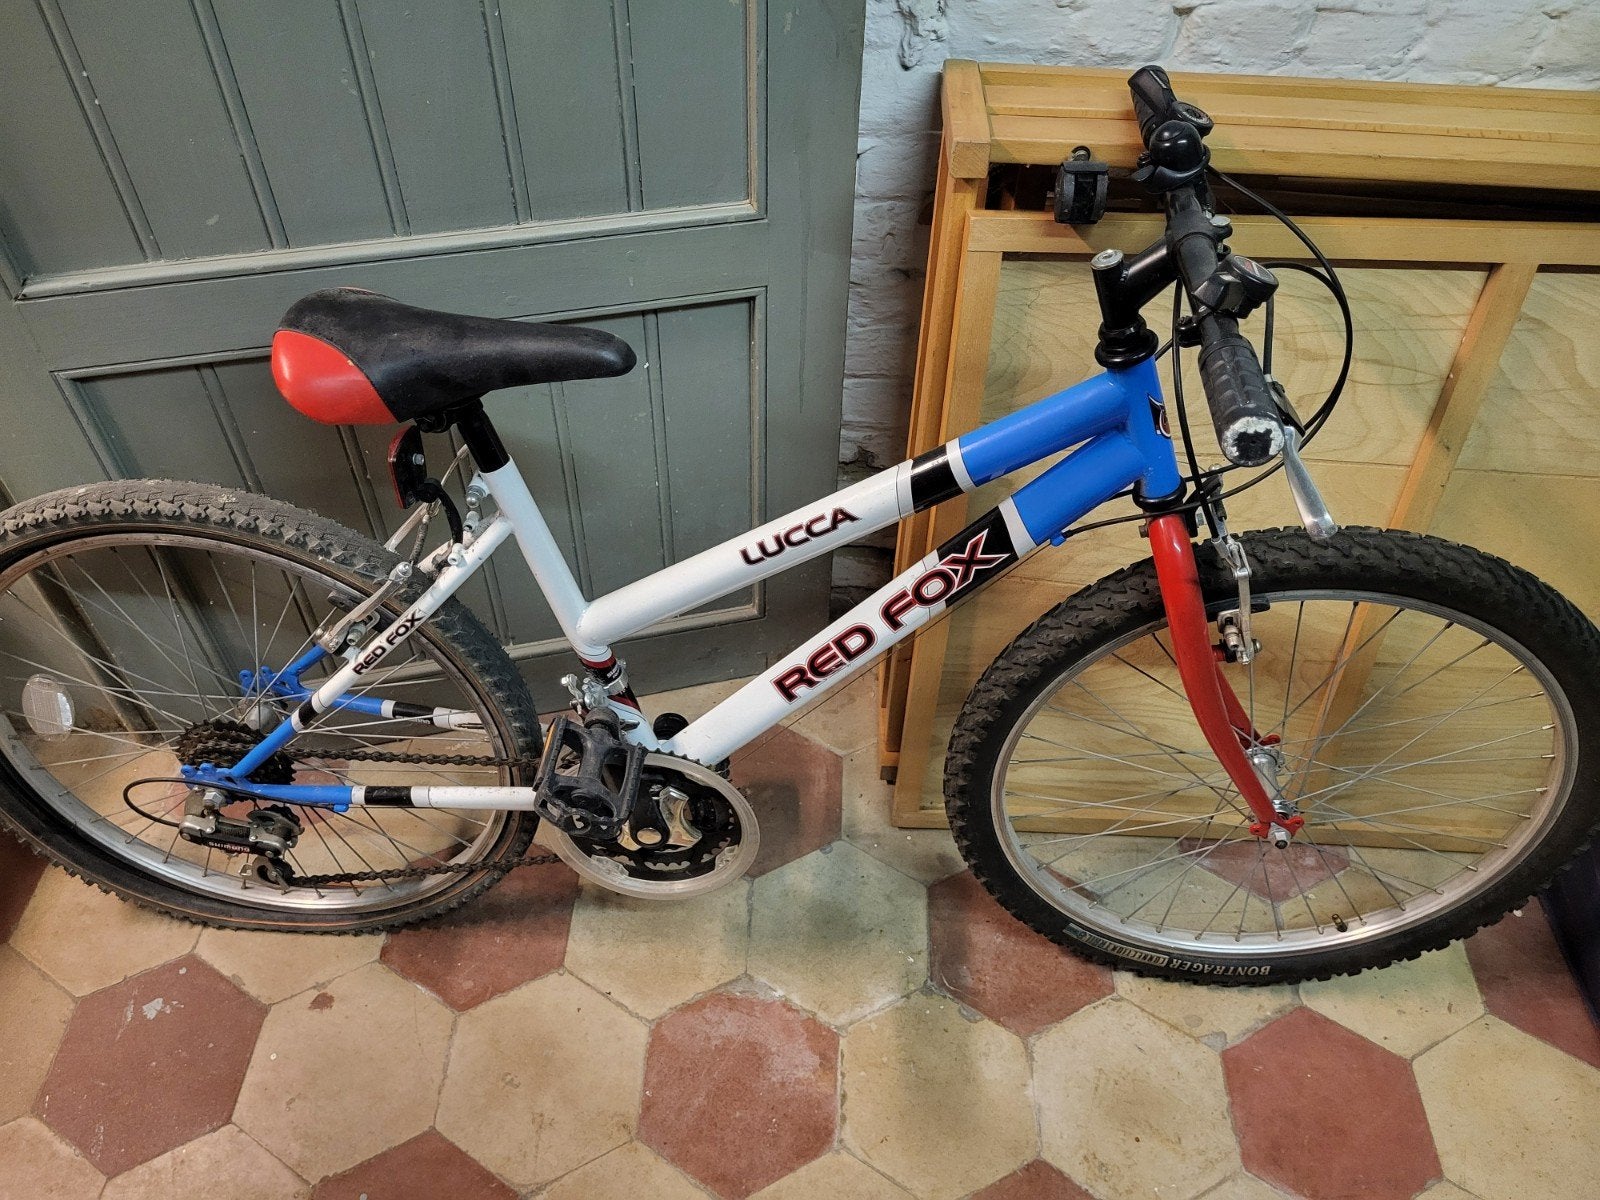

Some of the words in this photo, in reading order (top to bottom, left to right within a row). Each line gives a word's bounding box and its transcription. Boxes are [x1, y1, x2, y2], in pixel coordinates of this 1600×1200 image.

[739, 507, 860, 565] LUCCA
[352, 646, 387, 675] RED
[386, 610, 426, 645] FOX
[771, 623, 877, 704] RED
[880, 528, 1010, 632] FOX
[1169, 958, 1271, 976] BONTRAGER
